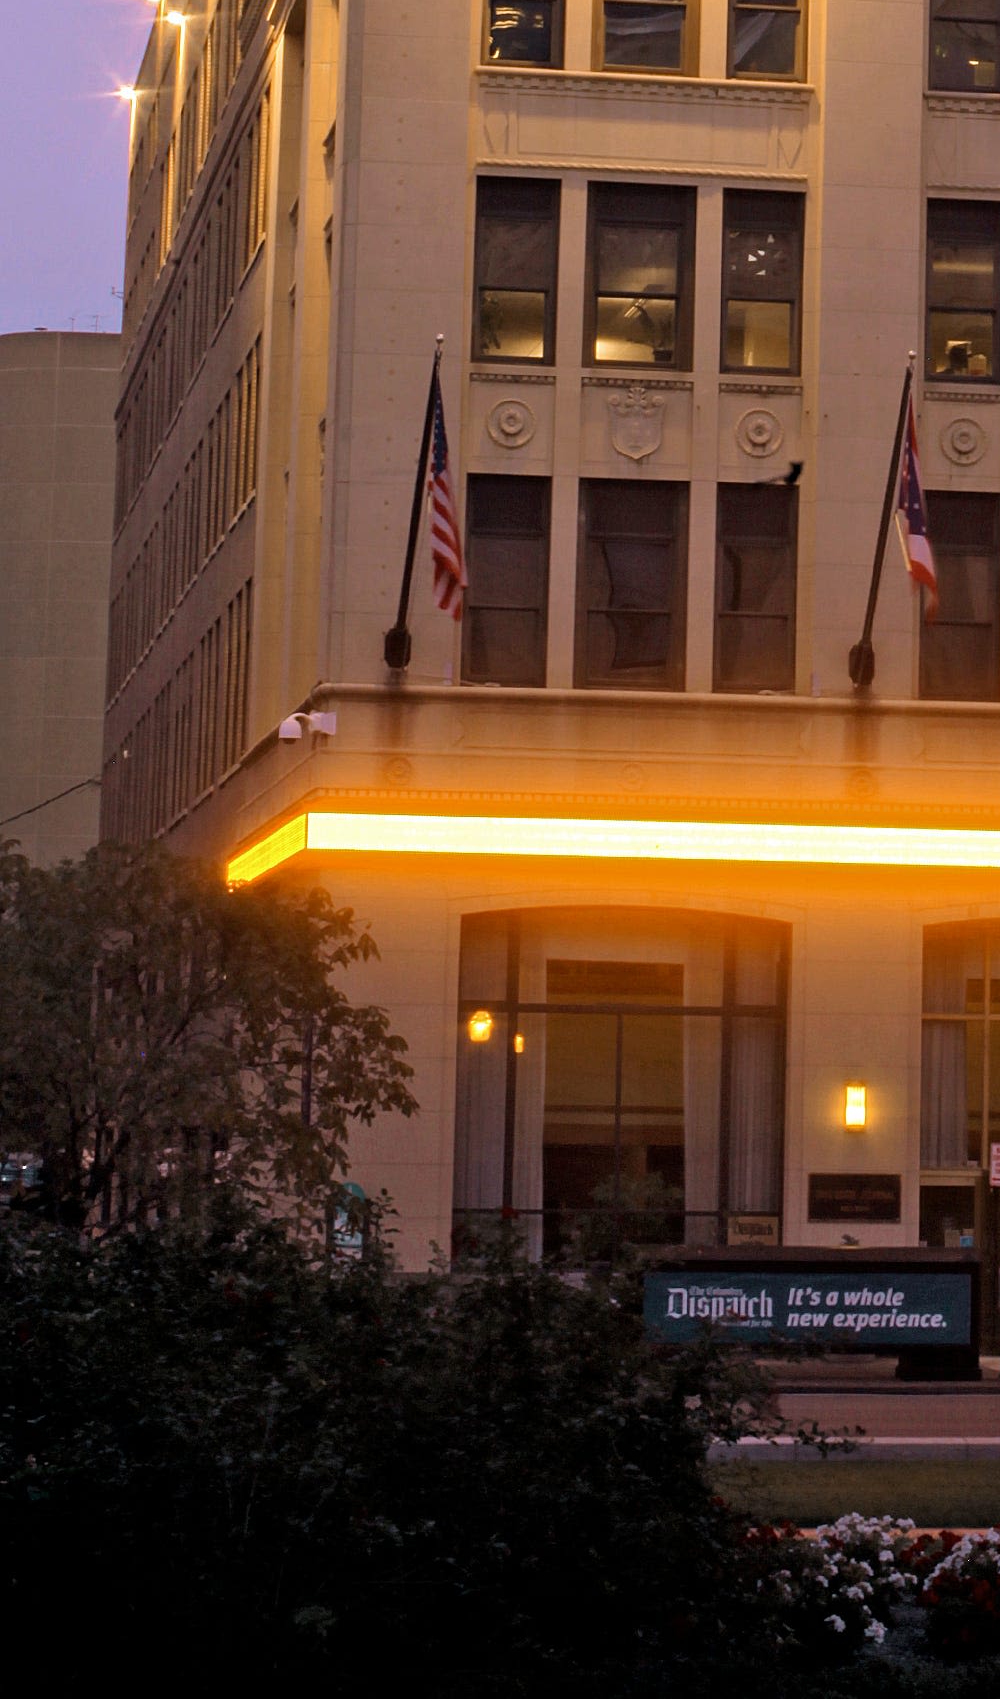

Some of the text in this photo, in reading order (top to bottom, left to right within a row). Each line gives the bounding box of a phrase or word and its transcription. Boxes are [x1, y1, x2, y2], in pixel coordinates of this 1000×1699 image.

[665, 1287, 773, 1324] Dispatch
[787, 1287, 905, 1306] It's a whole
[787, 1308, 947, 1332] new experience.
